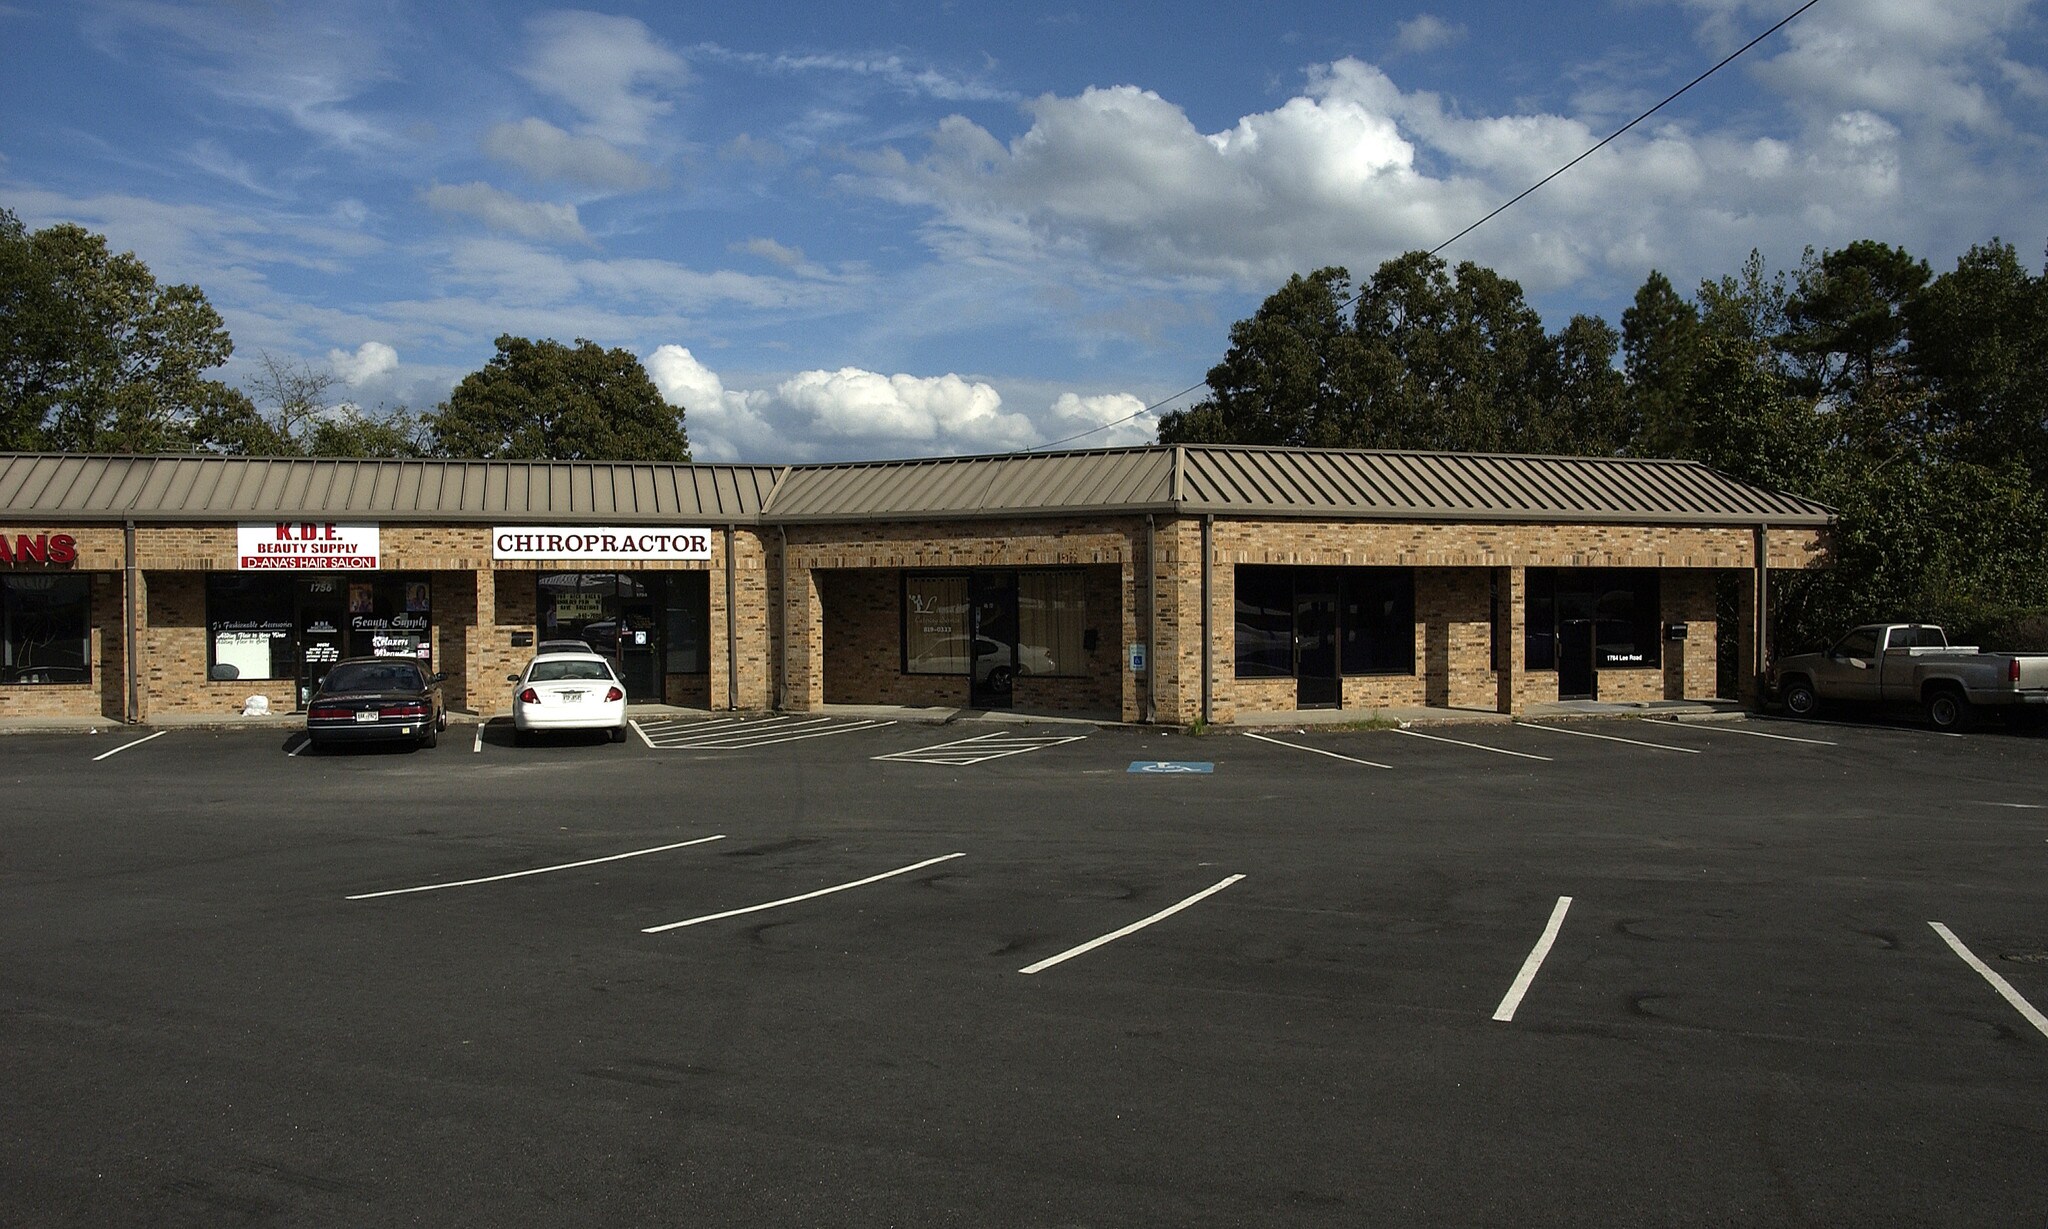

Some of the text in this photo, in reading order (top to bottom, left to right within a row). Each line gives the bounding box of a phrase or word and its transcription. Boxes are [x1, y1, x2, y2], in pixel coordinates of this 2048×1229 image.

[276, 522, 343, 540] K.D.E.
[257, 543, 358, 553] BEAUTY SUPPLY
[497, 534, 708, 552] CHIROPRACTOR
[247, 557, 372, 568] D-ANA'S HAIR SALON
[352, 616, 428, 628] Beauty Supply
